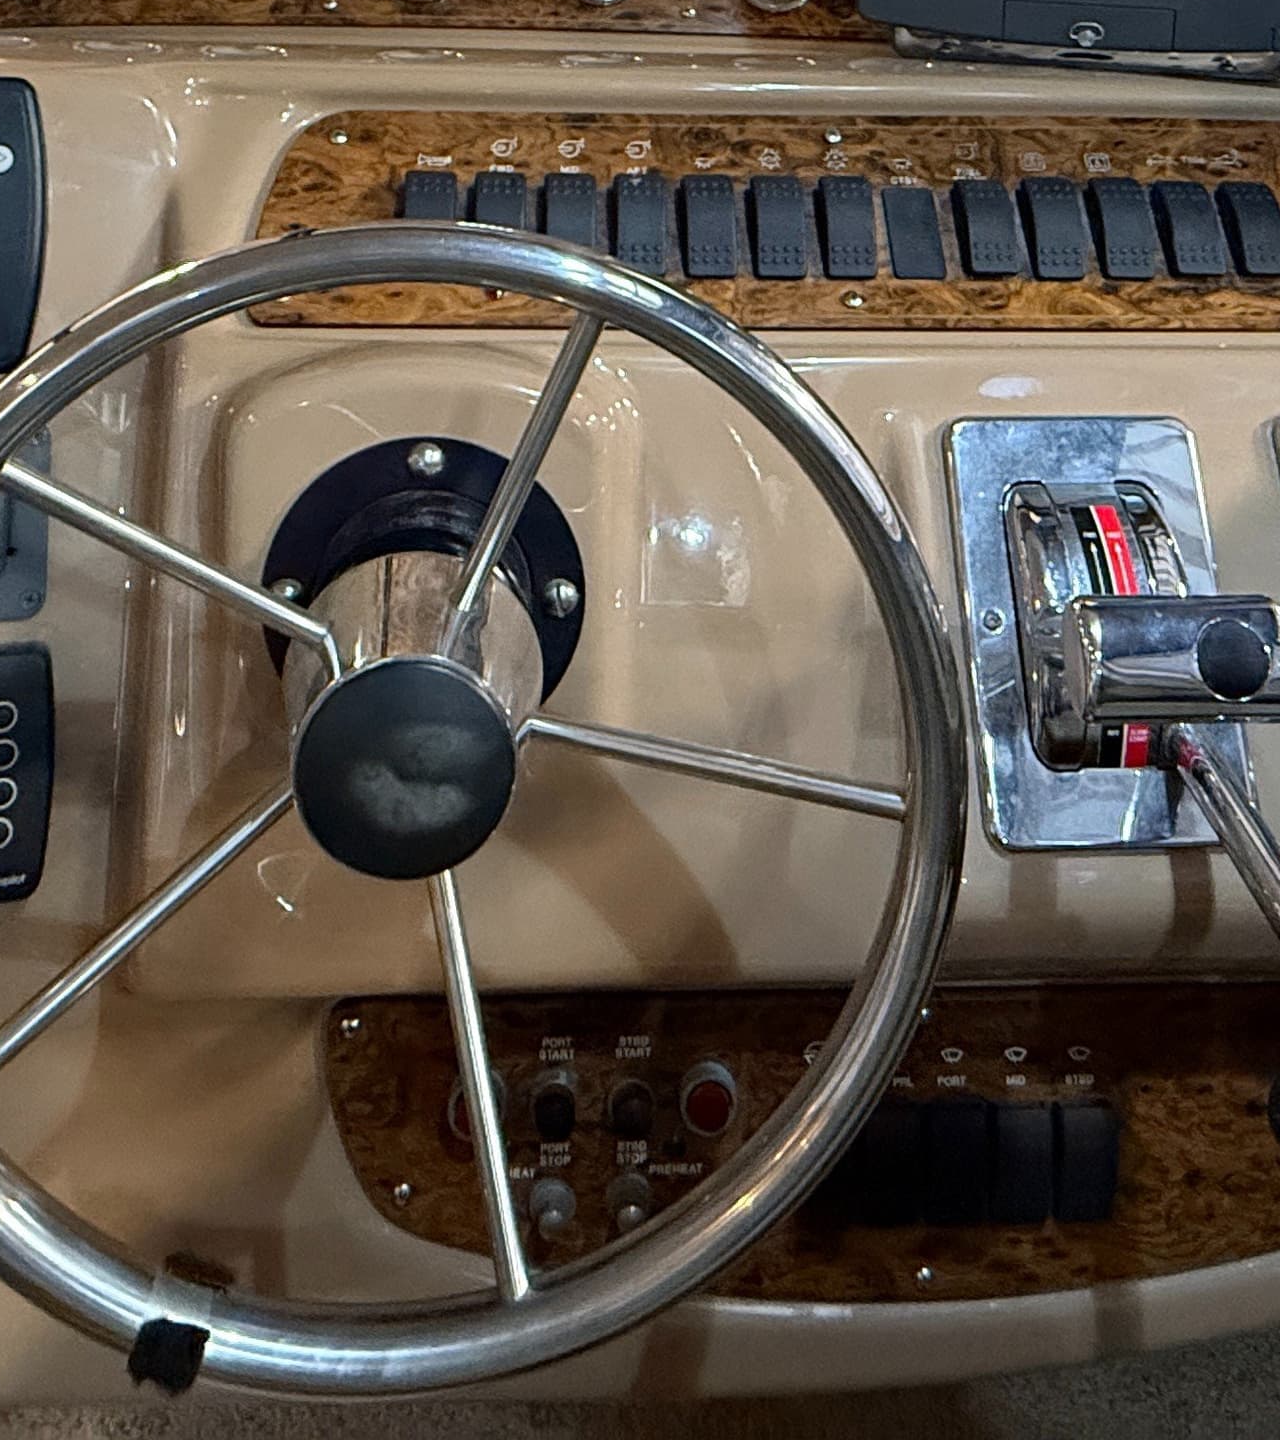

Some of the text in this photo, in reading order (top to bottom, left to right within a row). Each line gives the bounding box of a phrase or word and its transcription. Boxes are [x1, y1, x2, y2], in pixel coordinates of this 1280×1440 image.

[542, 1036, 573, 1048] PORT
[539, 1048, 576, 1061] START
[615, 1046, 652, 1059] START
[937, 1074, 967, 1088] PORT
[1006, 1074, 1026, 1086] MID
[540, 1142, 570, 1153] PORT
[539, 1154, 571, 1167] STOP
[648, 1162, 704, 1177] PREHEAT
